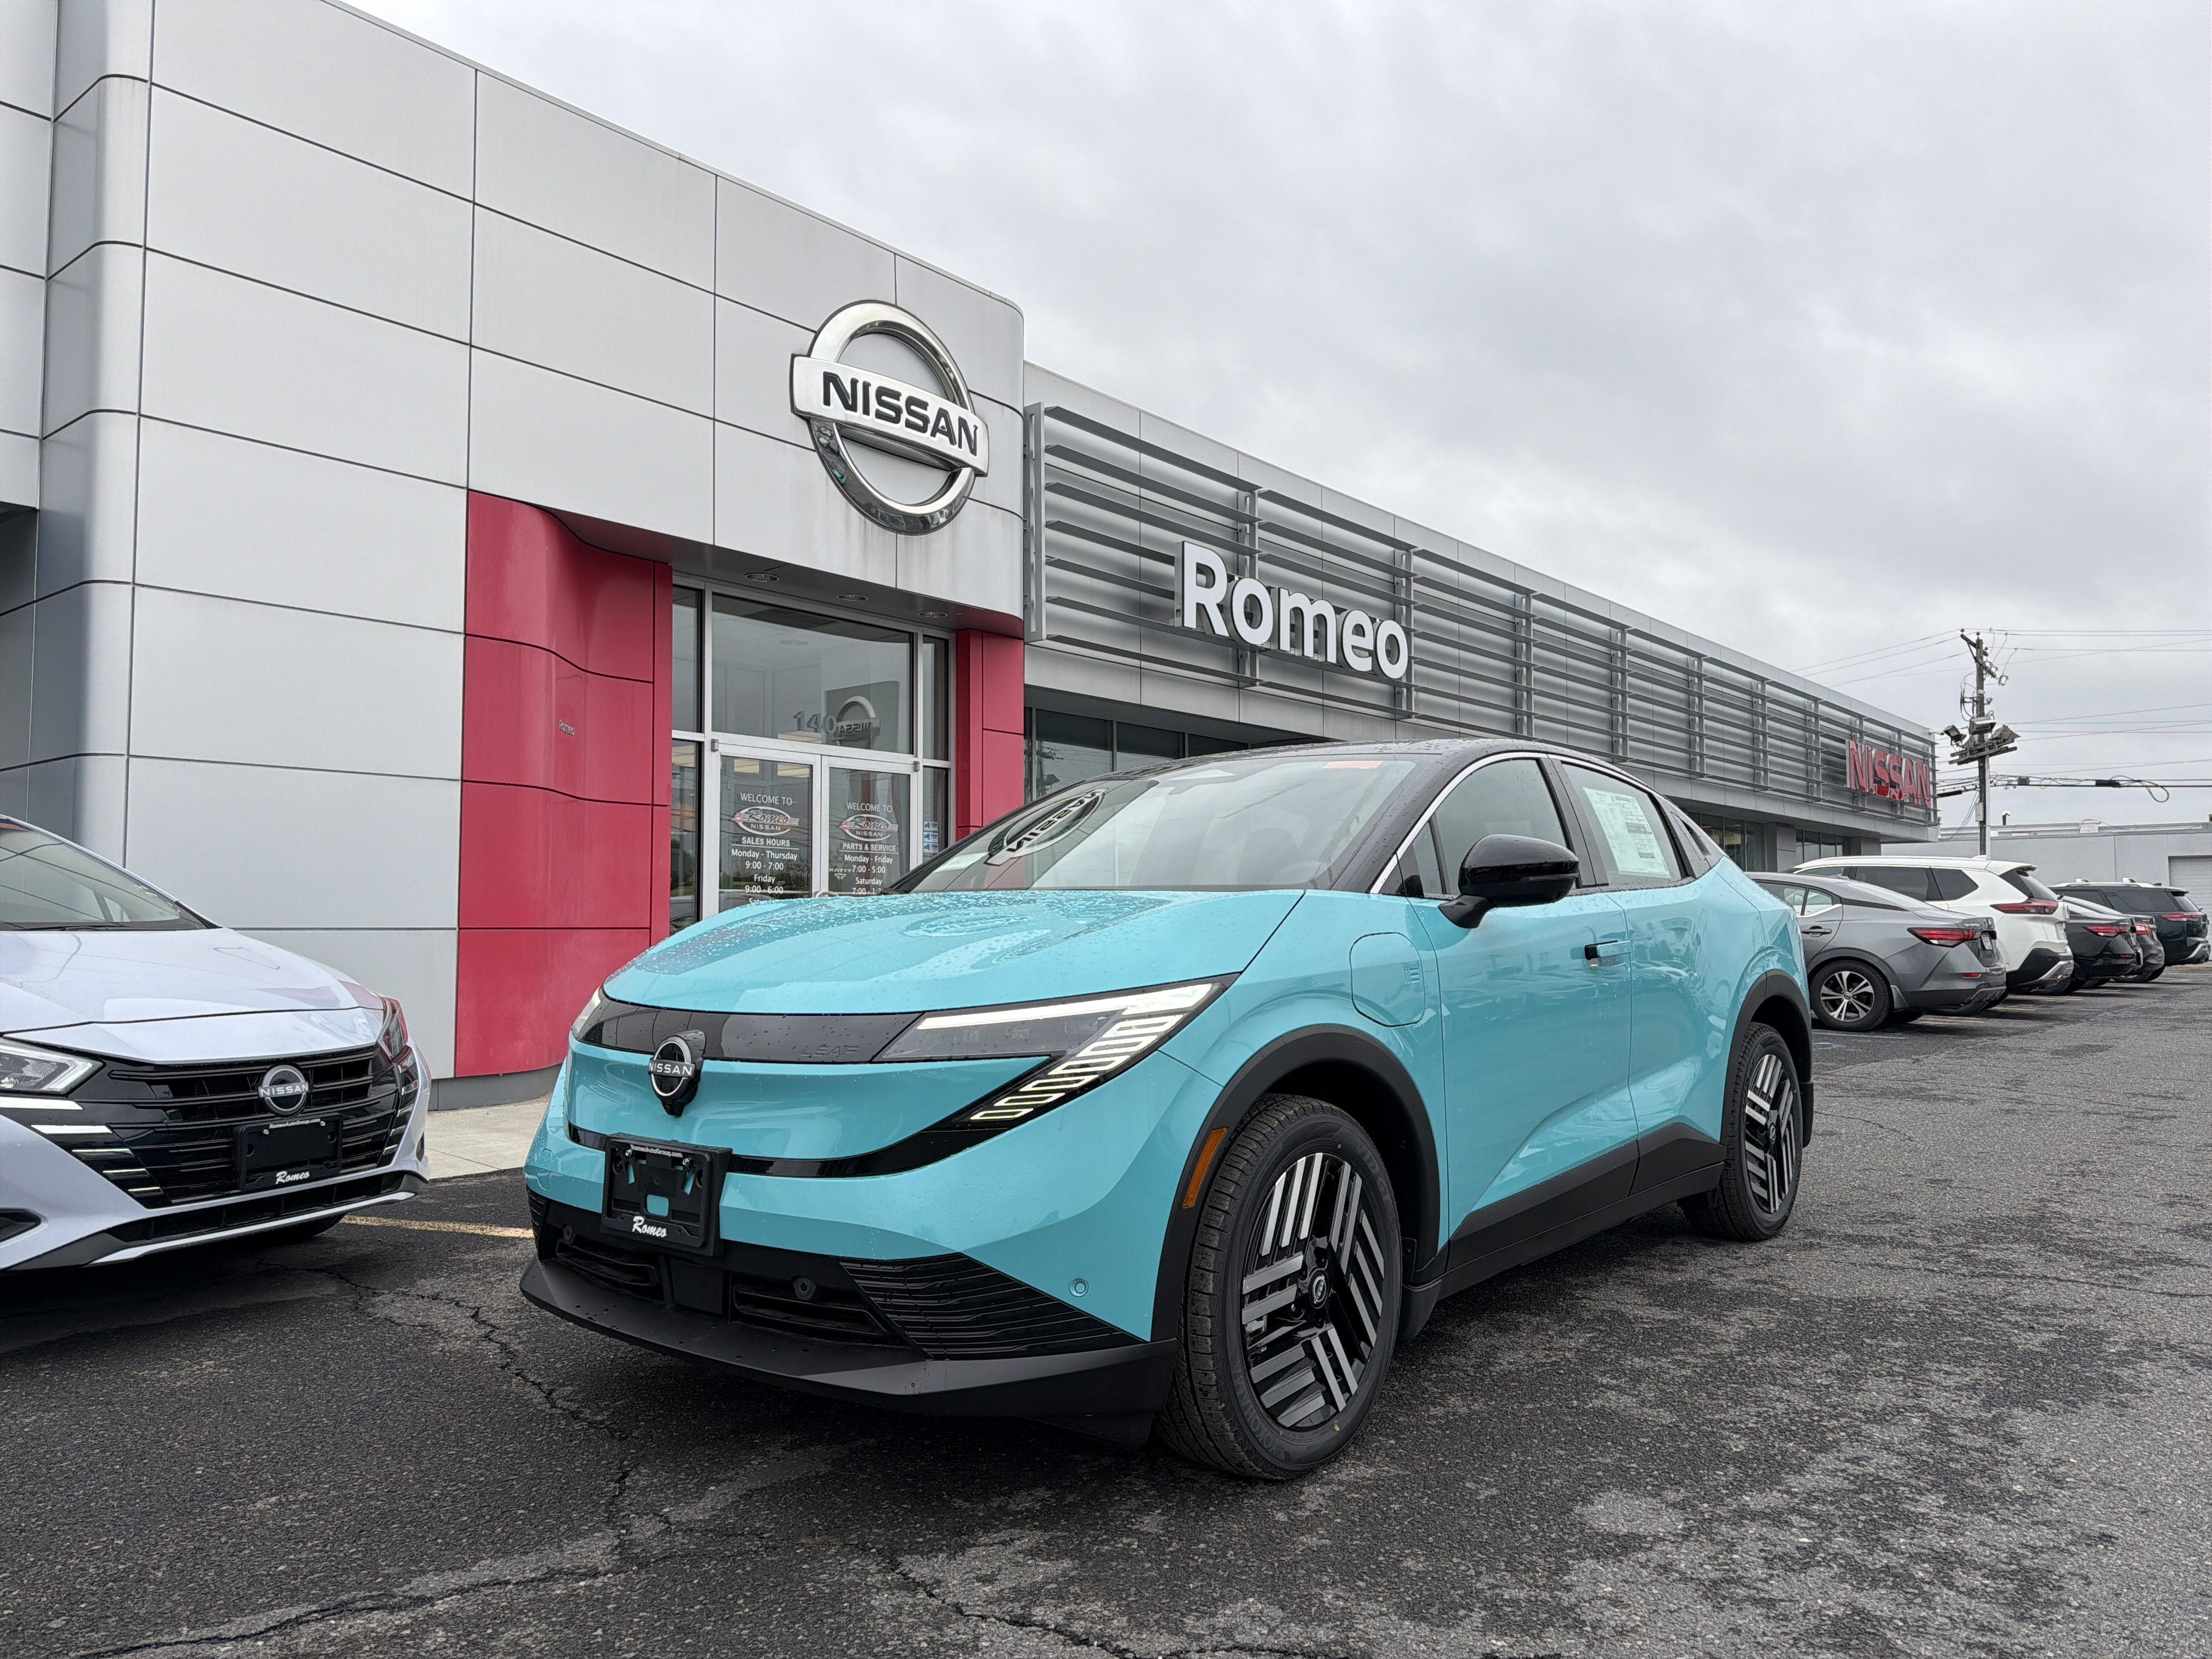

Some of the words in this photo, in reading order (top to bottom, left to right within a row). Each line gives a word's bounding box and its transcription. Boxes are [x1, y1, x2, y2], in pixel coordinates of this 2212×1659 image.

[823, 371, 978, 456] NISSAN
[1182, 540, 1409, 679] Romeo
[558, 719, 574, 736] Romeo
[793, 711, 837, 734] 140
[1849, 740, 1931, 808] NISSAN
[740, 793, 780, 804] WELCOME
[781, 797, 793, 805] TO
[847, 802, 881, 812] WELCOME
[743, 808, 789, 823] Romeo
[852, 815, 889, 830] Romeo
[742, 837, 764, 845] SALES
[766, 838, 790, 847] HOURS
[731, 849, 759, 859] Monday
[766, 851, 798, 861] Thursday
[845, 855, 869, 864] Monday
[874, 856, 893, 865] Friday
[746, 861, 761, 870] 9:00
[768, 862, 784, 871] 7:00
[754, 874, 775, 884] Friday
[856, 877, 882, 887] Saturday
[745, 885, 761, 893] 9:00
[768, 886, 783, 894] 6:00
[800, 1045, 859, 1056] LEAF
[649, 1062, 692, 1076] NISSAN
[261, 1083, 308, 1096] NISSAN
[269, 1118, 320, 1128] RomeoAutoGroup.com
[630, 1144, 683, 1158] RomeoAutoGroup.com
[275, 1171, 310, 1184] Romeo
[632, 1216, 667, 1238] Romeo
